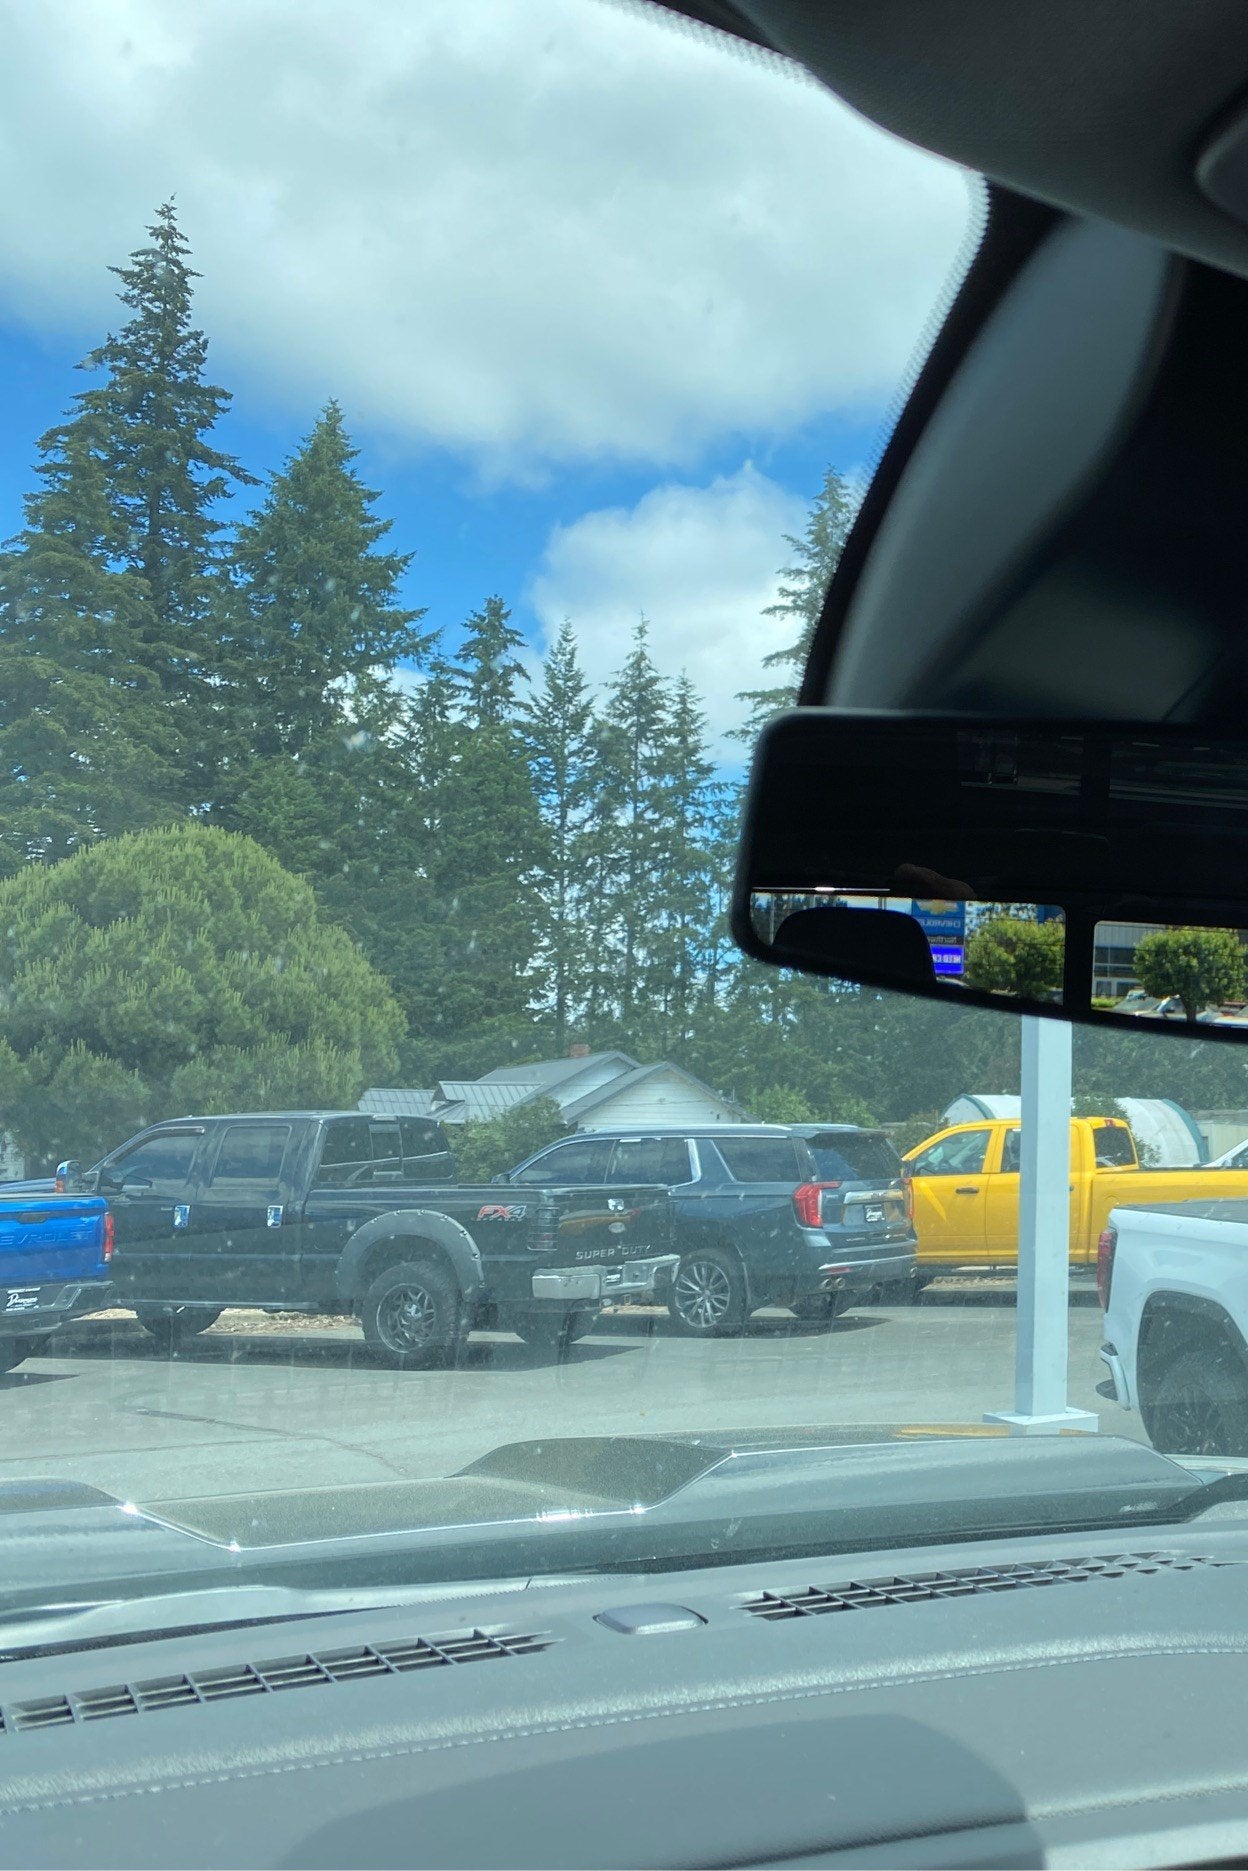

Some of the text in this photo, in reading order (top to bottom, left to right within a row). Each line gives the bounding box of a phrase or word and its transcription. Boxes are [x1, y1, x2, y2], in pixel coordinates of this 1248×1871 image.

[477, 1204, 527, 1219] FX4
[0, 1230, 93, 1246] EVROLET
[575, 1244, 651, 1260] SUPER DUTY
